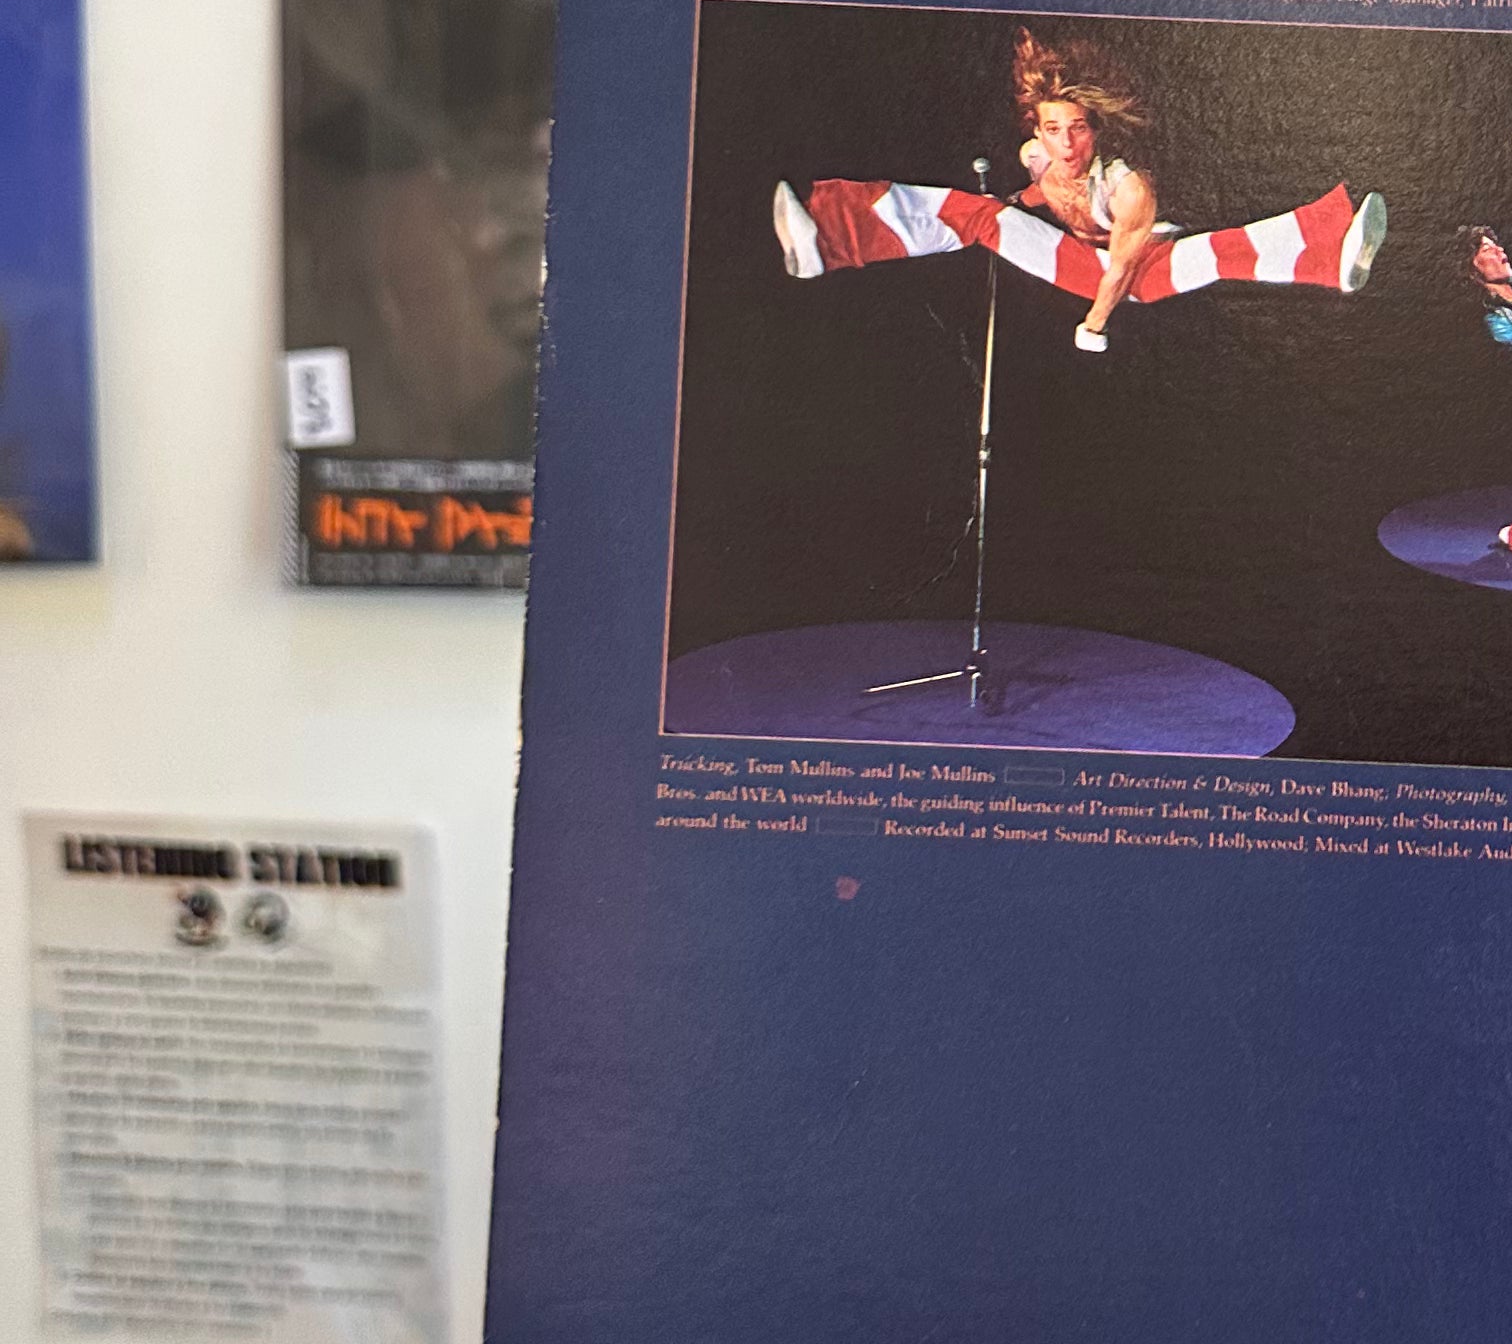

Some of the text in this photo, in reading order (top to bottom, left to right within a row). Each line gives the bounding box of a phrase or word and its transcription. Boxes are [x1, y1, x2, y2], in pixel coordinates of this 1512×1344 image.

[660, 754, 739, 777] Trucking,
[746, 757, 785, 775] Tom
[789, 759, 855, 777] Mullins
[859, 761, 894, 779] and
[930, 764, 996, 784] Mullins
[1072, 771, 1103, 788] Art
[1107, 772, 1188, 791] Direction
[1213, 775, 1275, 797] Design,
[1280, 778, 1326, 796] Dave
[1395, 781, 1508, 807] Photography,
[704, 785, 739, 803] and
[889, 792, 918, 809] the
[919, 793, 985, 815] guiding
[988, 795, 1065, 814] influence
[1088, 798, 1155, 818] Premier
[1218, 804, 1252, 822] The
[1255, 806, 1301, 824] Road
[1302, 808, 1389, 831] Company,
[1391, 811, 1420, 829] the
[1421, 812, 1499, 832] Sheraton
[654, 812, 718, 831] around
[722, 814, 750, 831] the
[756, 815, 808, 833] world
[883, 819, 966, 839] Recorded
[970, 823, 987, 840] at
[992, 824, 1049, 843] Sunset
[1054, 827, 1110, 845] Sound
[1314, 835, 1370, 853] Mixed
[1373, 837, 1390, 854] at
[1396, 837, 1473, 858] Westlake
